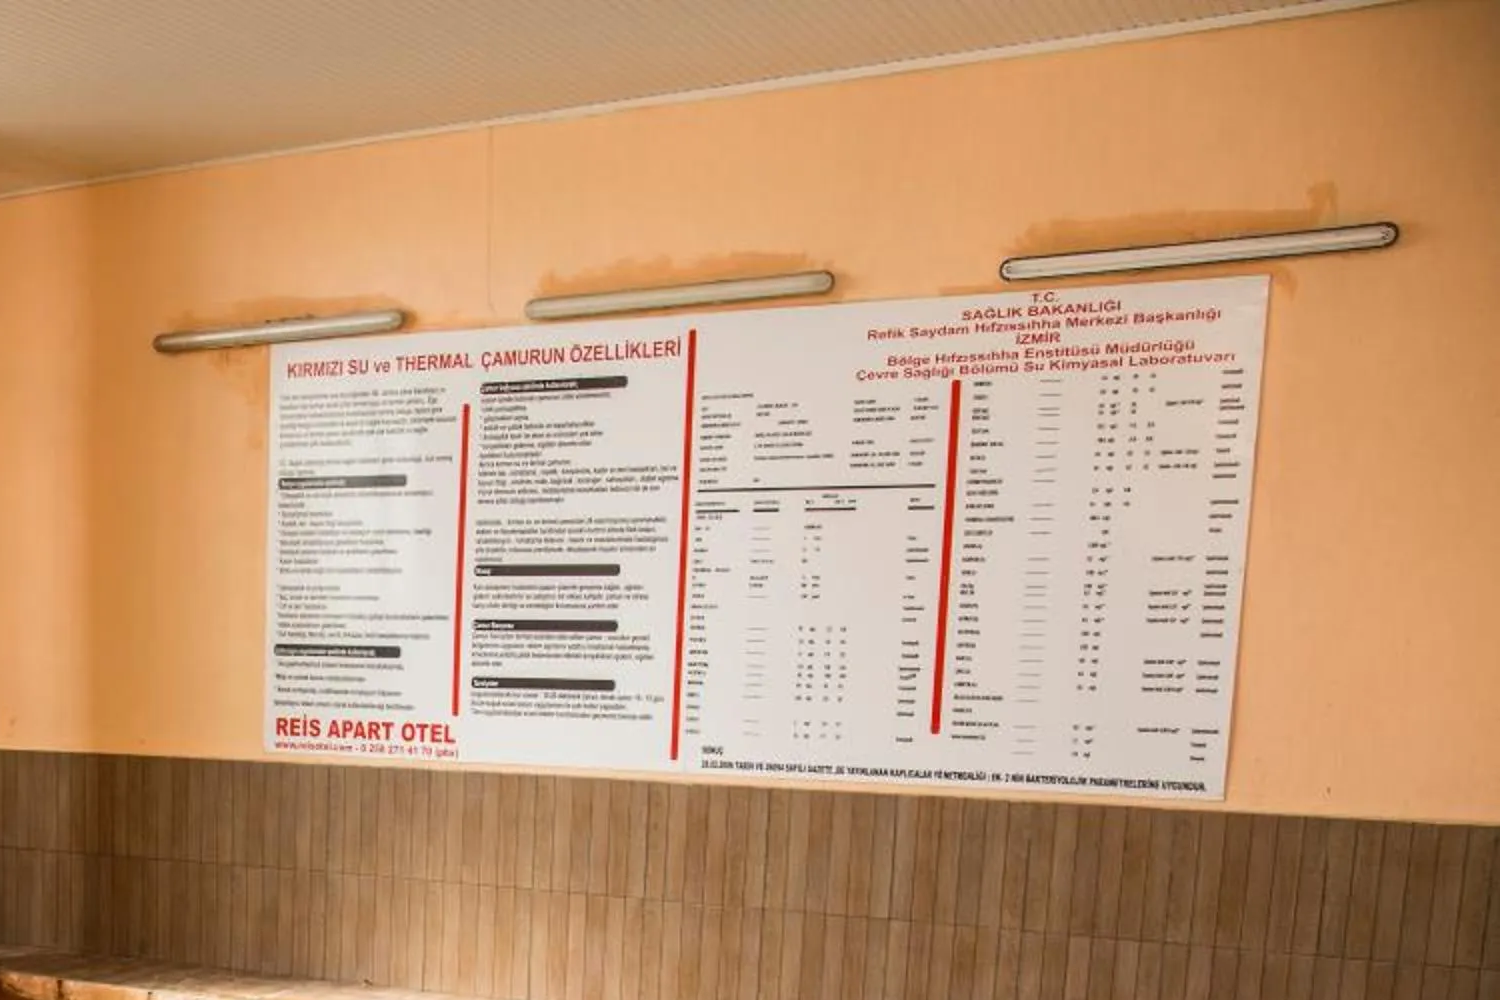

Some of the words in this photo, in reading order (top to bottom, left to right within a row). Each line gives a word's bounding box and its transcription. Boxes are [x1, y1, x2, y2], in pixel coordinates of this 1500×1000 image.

[961, 306, 1023, 321] SAĞLIK
[1027, 300, 1122, 317] BAKANLIĞI
[1031, 292, 1060, 303] T.C.
[867, 328, 905, 342] Refik
[909, 324, 969, 340] Saydam
[1065, 313, 1128, 329] Merkezi
[1133, 307, 1222, 325] Başkanlığı
[1015, 330, 1061, 345] İZMİR
[287, 361, 344, 378] KIRMIZI
[347, 359, 369, 375] SU
[373, 360, 391, 373] ve
[395, 352, 474, 372] THERMAL
[481, 347, 565, 372] ÇAMURUN
[570, 336, 682, 363] ÖZELLİKLERİ
[887, 354, 931, 368] Bölge
[1024, 343, 1100, 359] Enstitüsü
[1105, 339, 1195, 355] Müdürlüğü
[959, 360, 1019, 375] Bölümü
[1023, 360, 1044, 371] Su
[1049, 355, 1123, 371] Kimyasal
[1129, 351, 1236, 367] Laboratuvarı
[275, 714, 321, 737] REİS
[327, 719, 394, 741] APART
[401, 723, 456, 744] OTEL
